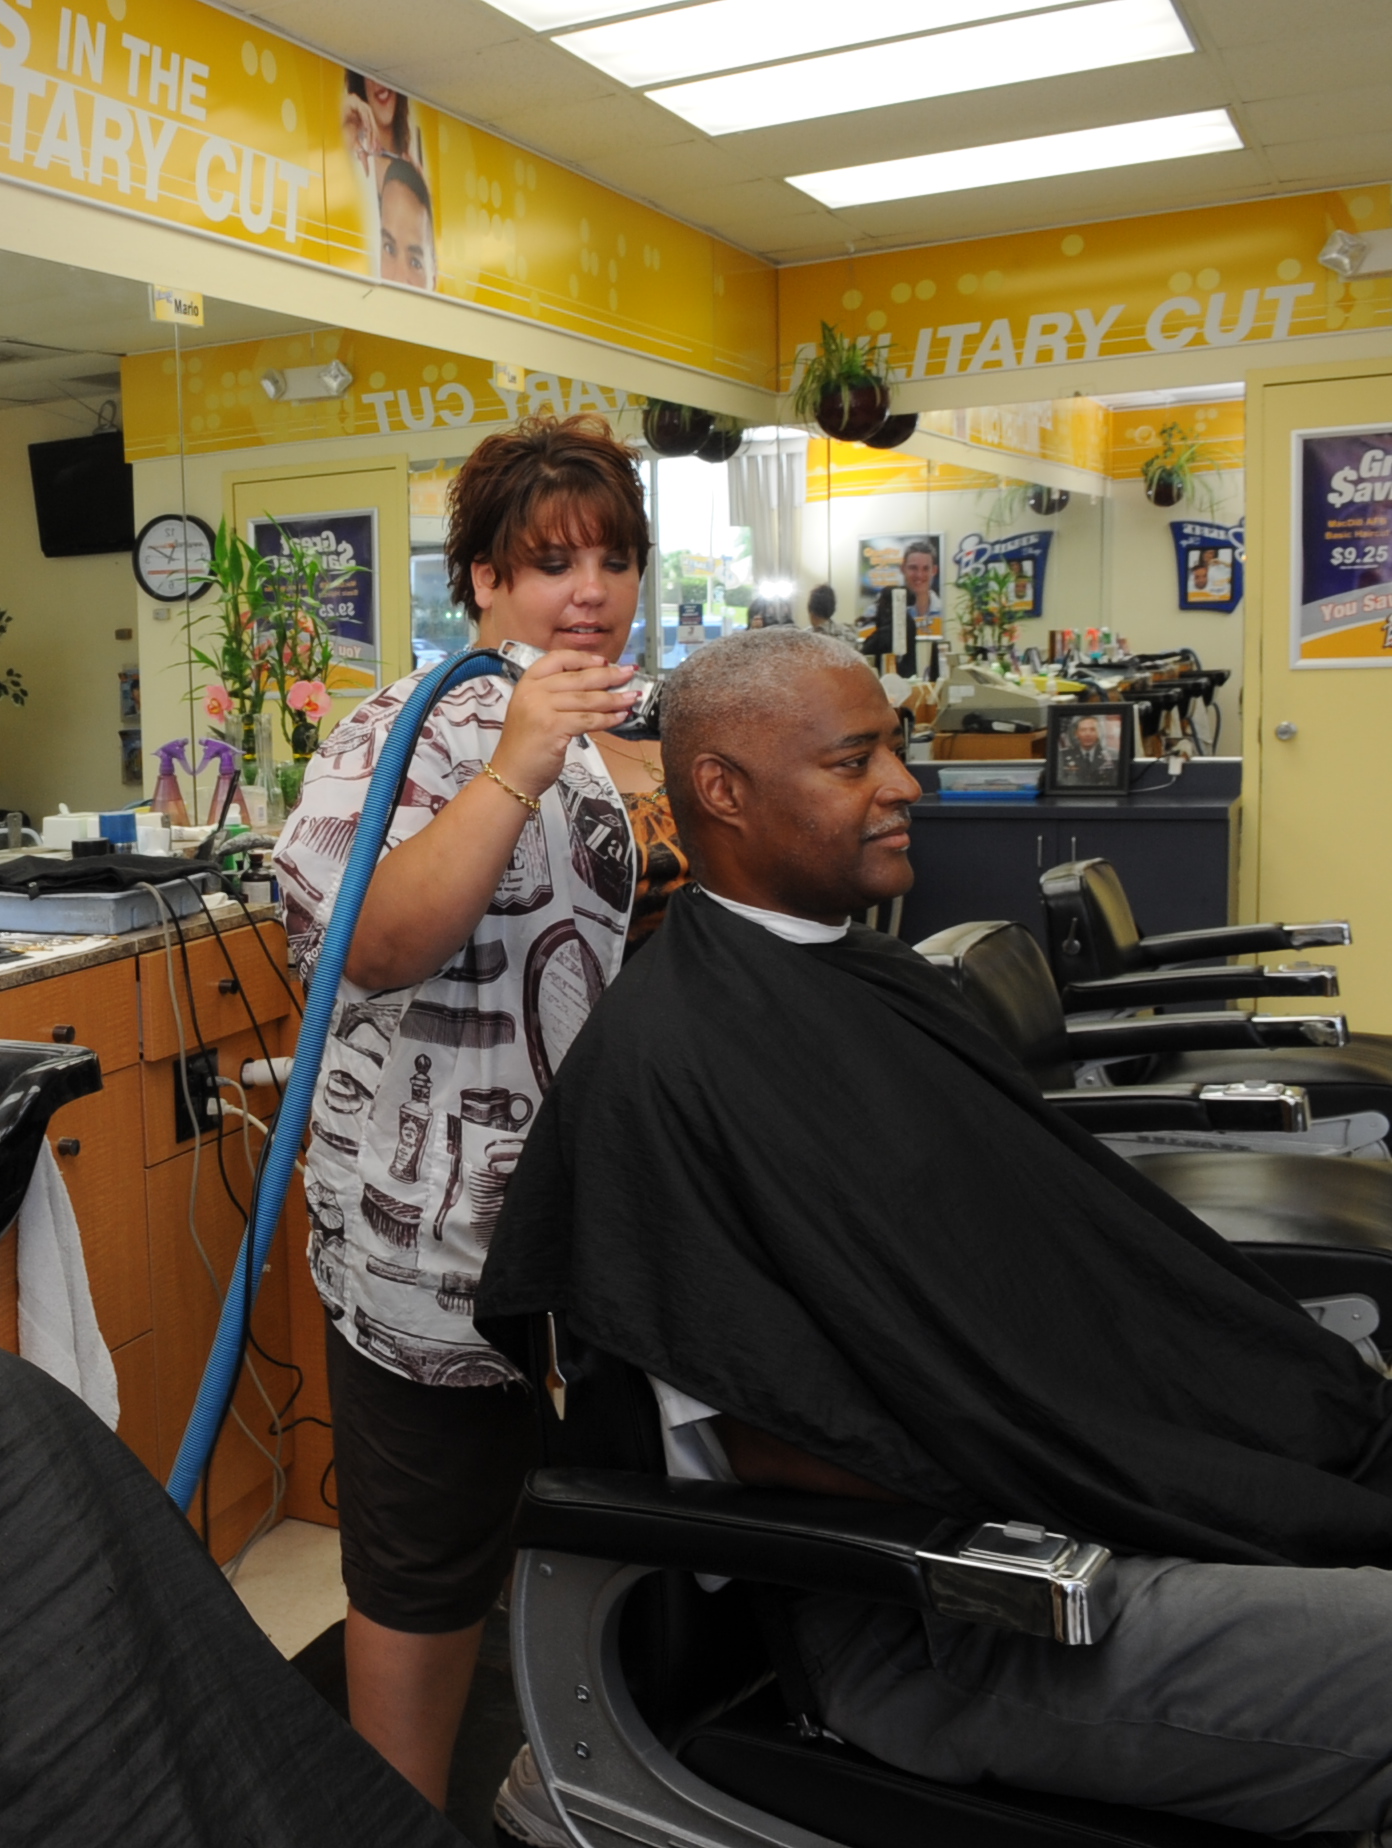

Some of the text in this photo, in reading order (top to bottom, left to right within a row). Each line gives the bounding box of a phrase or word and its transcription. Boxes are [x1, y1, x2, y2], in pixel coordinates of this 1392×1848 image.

[57, 7, 106, 84] IN
[120, 32, 209, 122] THE
[195, 135, 314, 244] CUT
[1144, 282, 1315, 352] CUT
[1330, 546, 1388, 566] $9.25
[1321, 601, 1357, 622] You
